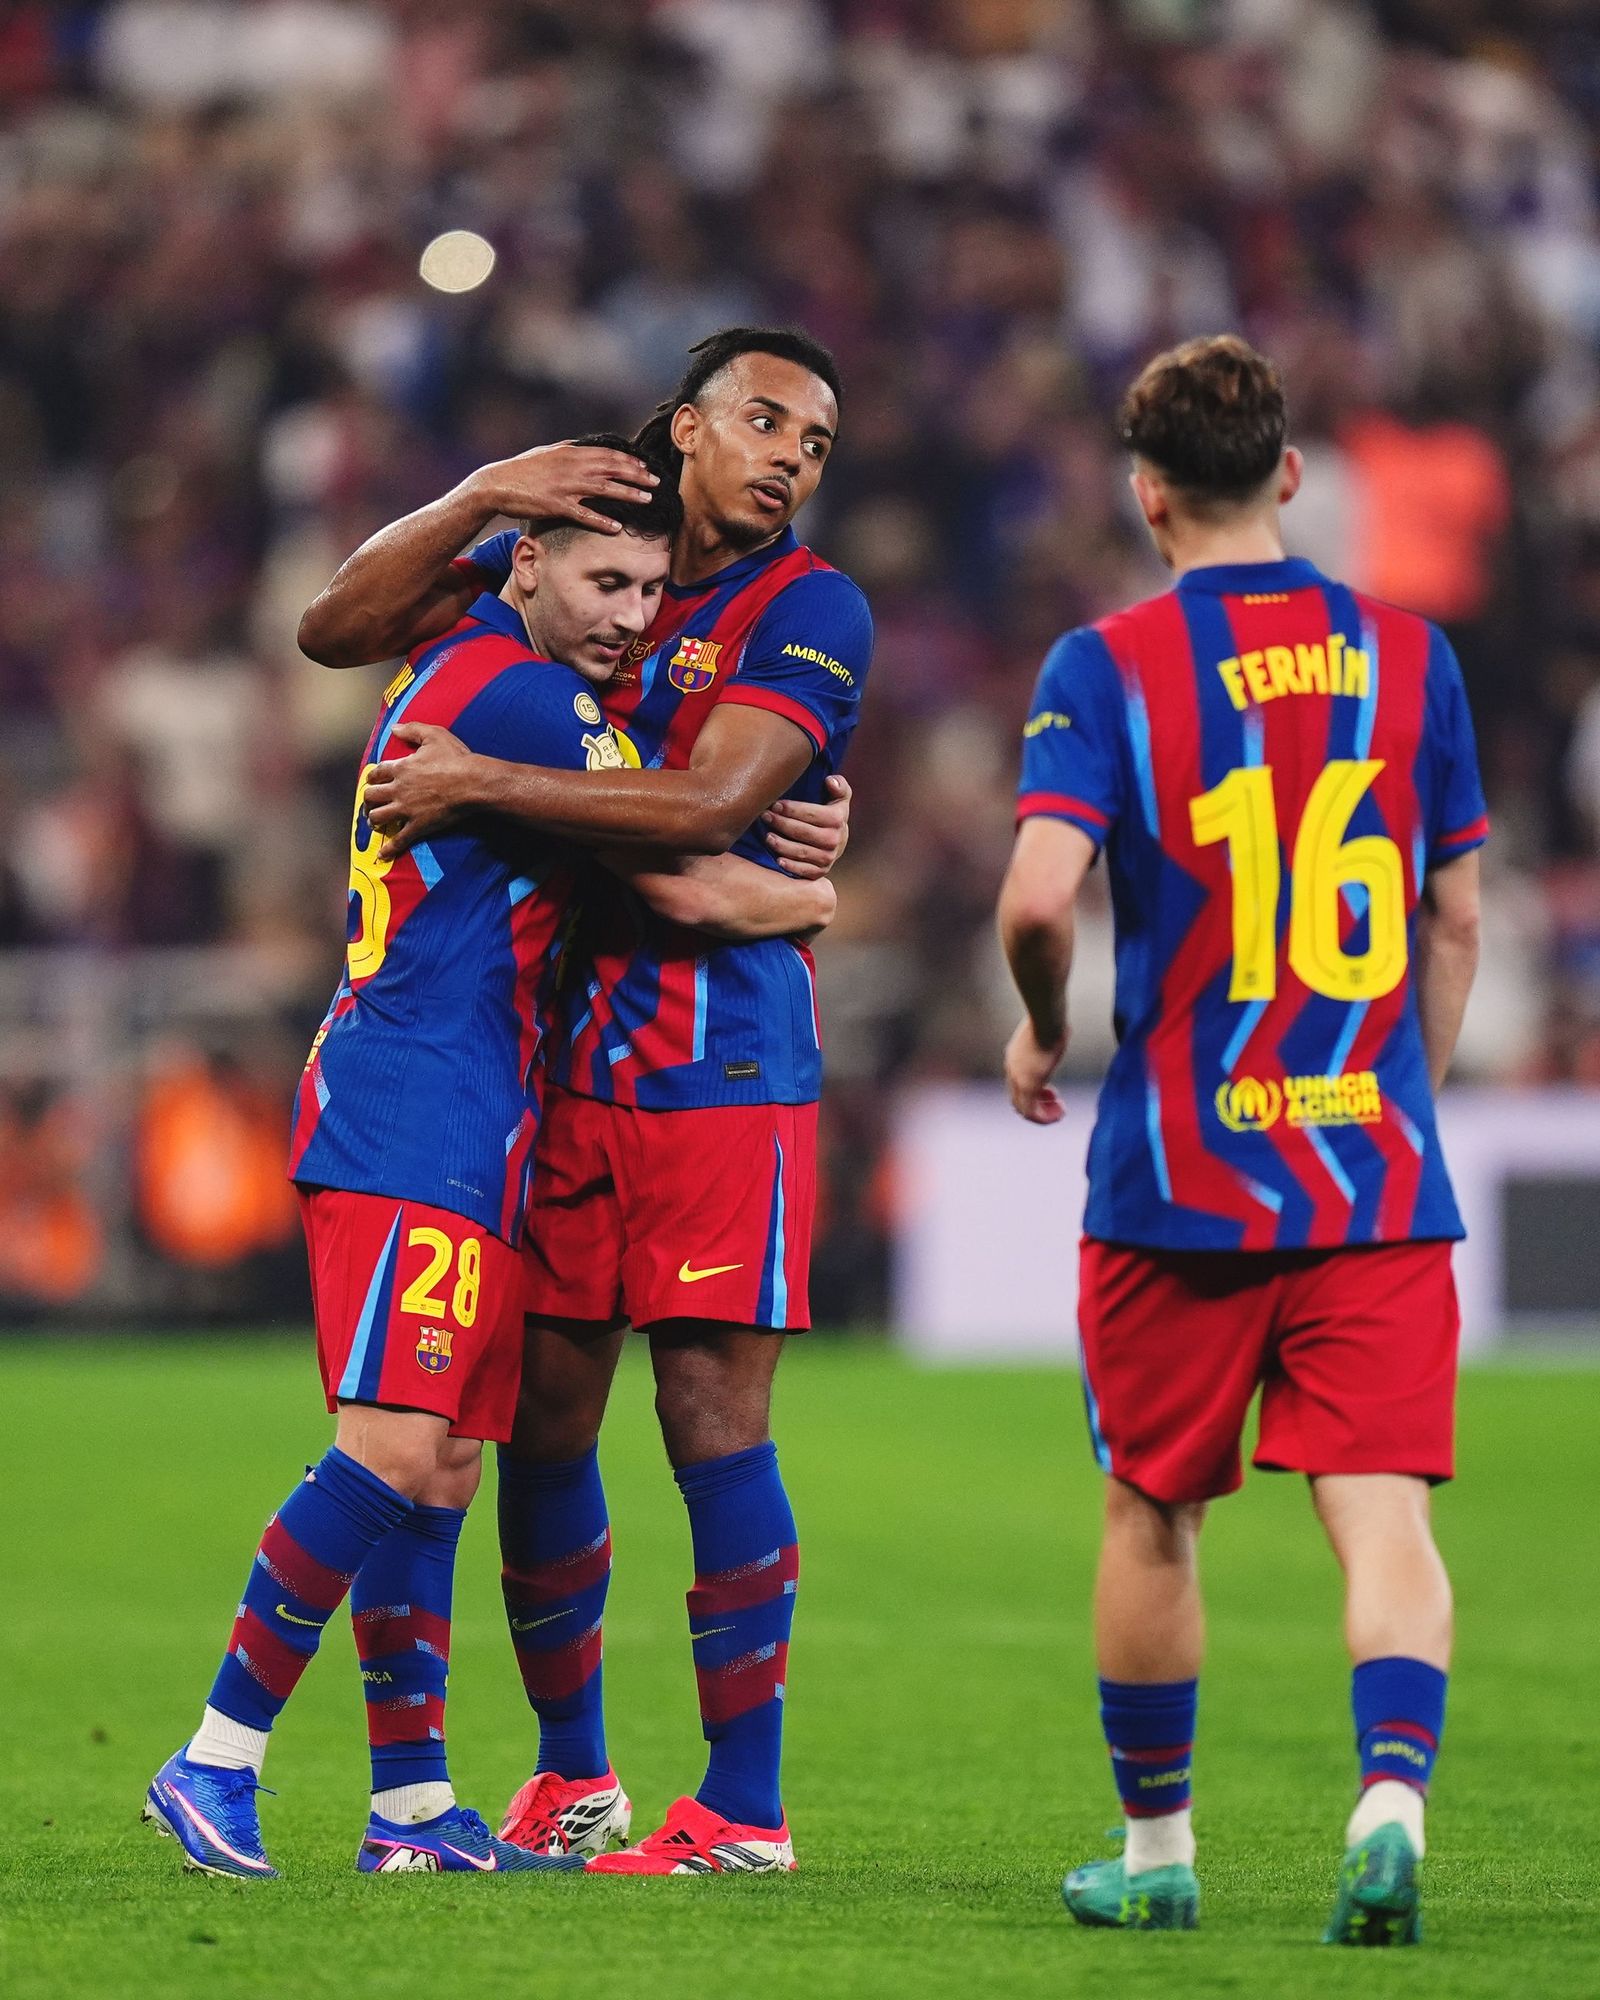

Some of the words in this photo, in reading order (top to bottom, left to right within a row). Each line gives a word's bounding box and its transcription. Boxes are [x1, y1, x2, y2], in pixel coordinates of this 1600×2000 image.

[781, 643, 850, 682] AMBILIGHT
[1217, 635, 1370, 710] FERMÍN
[581, 701, 595, 713] 15
[1189, 761, 1408, 1002] 16
[400, 1227, 481, 1328] 28
